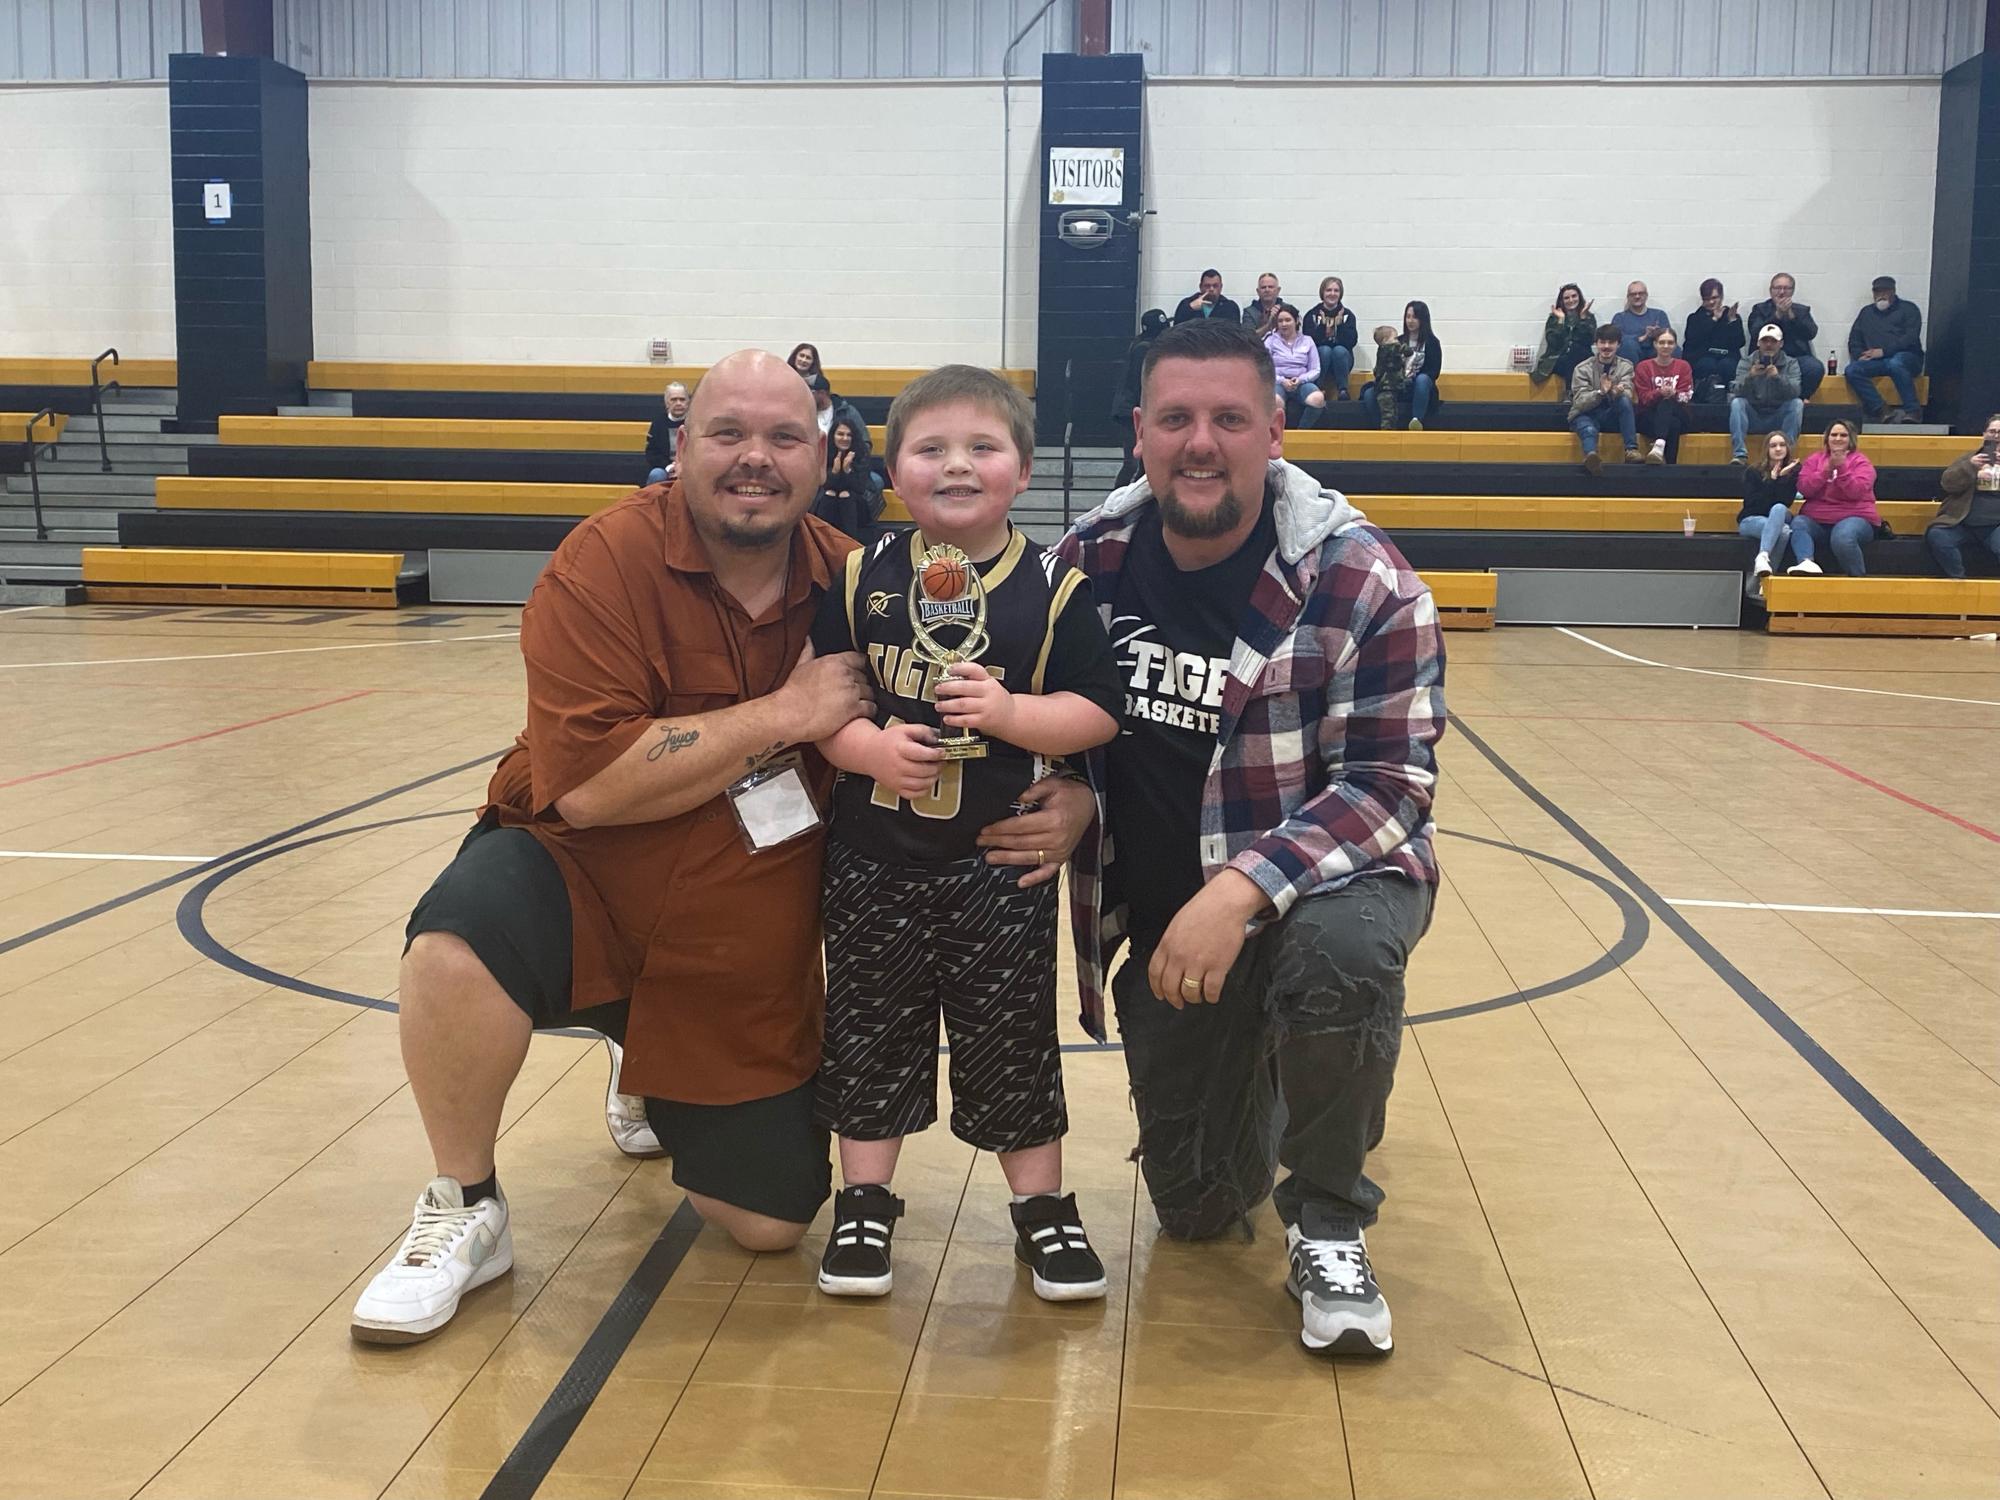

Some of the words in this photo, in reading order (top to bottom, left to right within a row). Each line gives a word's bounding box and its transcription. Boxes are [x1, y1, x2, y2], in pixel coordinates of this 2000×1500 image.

[1051, 158, 1123, 188] VISITORS
[214, 193, 222, 208] 1
[924, 599, 970, 618] BASKETBALL
